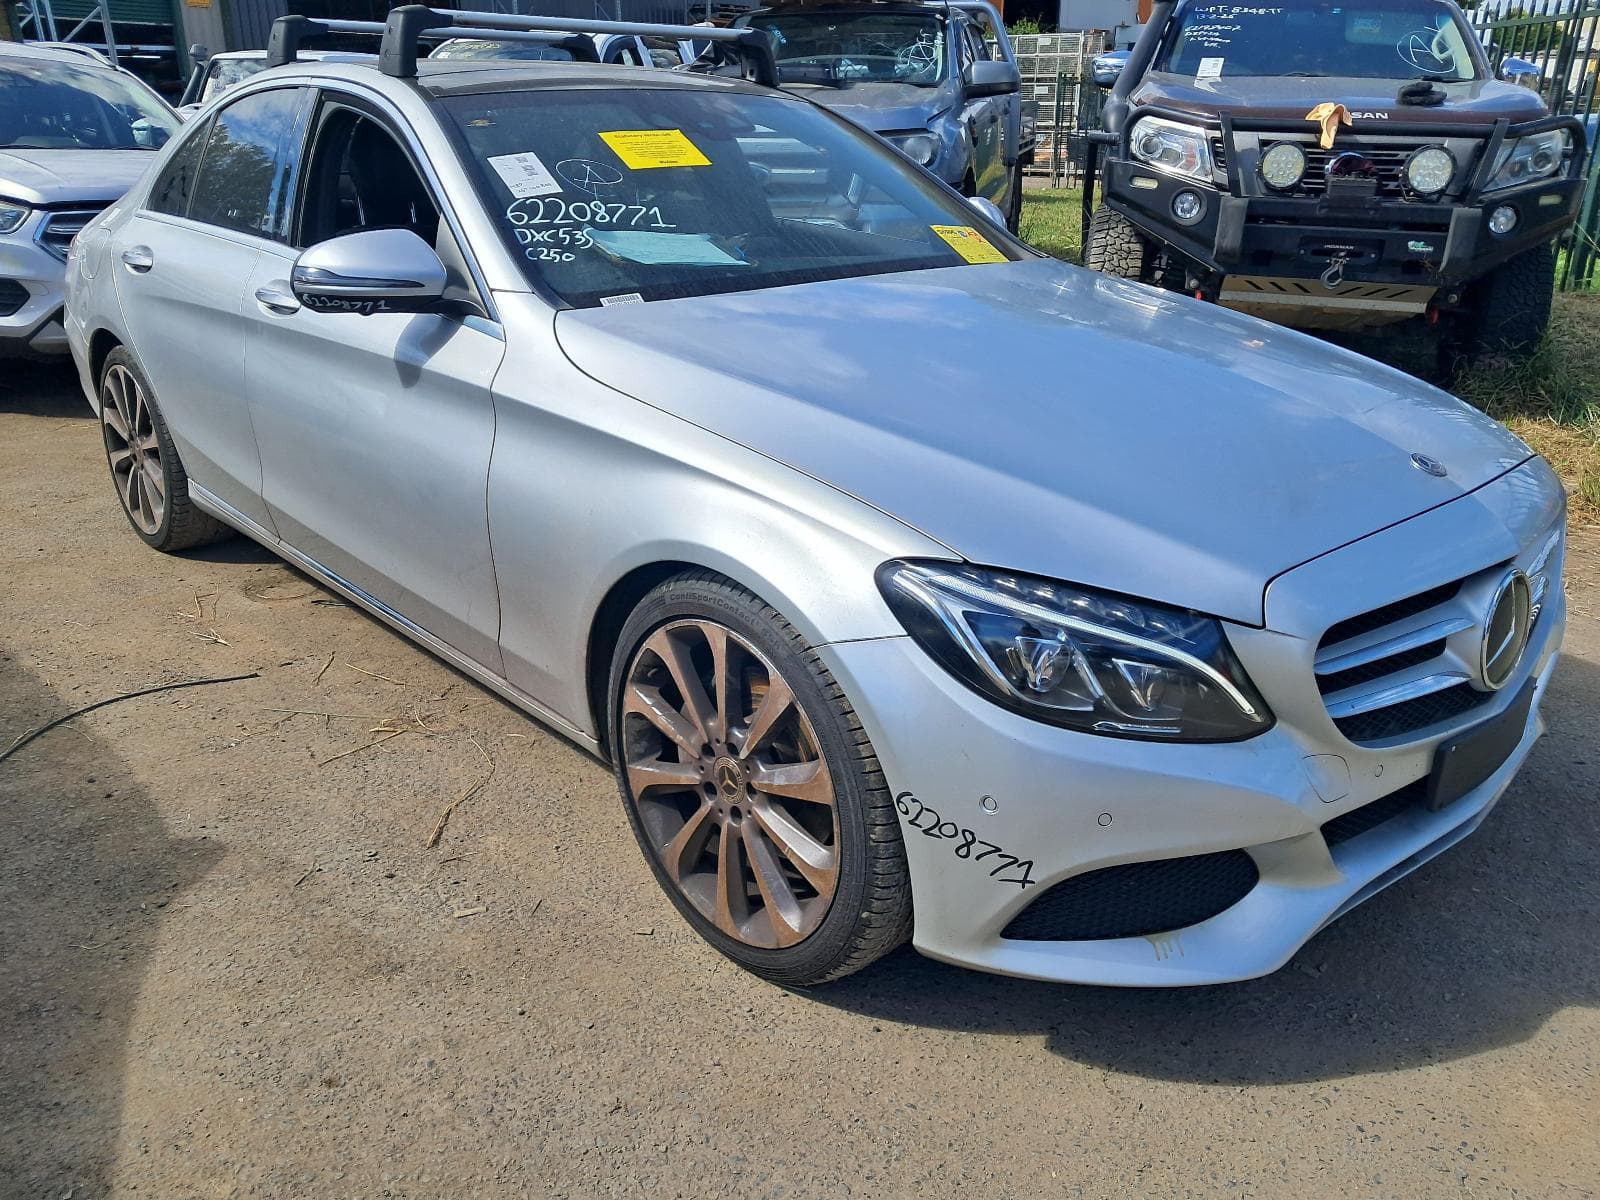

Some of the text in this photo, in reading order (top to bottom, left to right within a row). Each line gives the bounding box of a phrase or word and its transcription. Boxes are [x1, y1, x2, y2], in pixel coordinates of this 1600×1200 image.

[1351, 111, 1389, 120] SAN
[505, 198, 676, 228] 62208771
[525, 247, 576, 263] C250
[302, 293, 391, 313] 62208771
[896, 791, 1036, 889] 62208771
